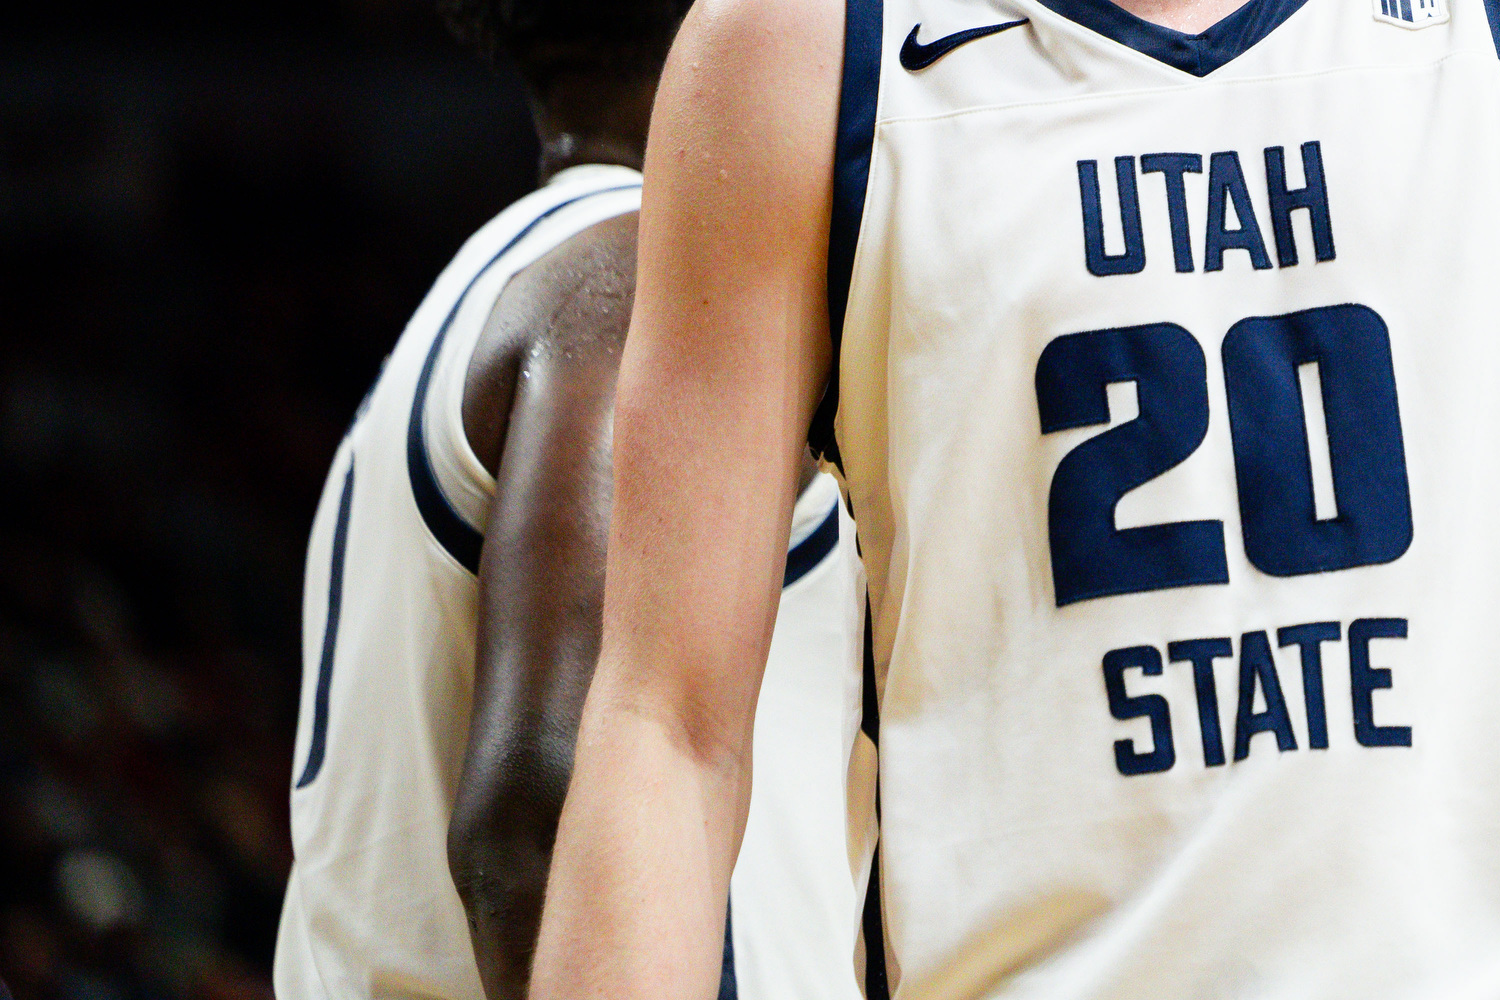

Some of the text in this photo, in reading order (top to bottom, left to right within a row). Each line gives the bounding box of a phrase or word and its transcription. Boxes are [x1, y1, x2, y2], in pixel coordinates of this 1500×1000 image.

[1076, 140, 1337, 278] UTAH
[1034, 302, 1414, 609] 20
[1101, 617, 1413, 777] STATE
